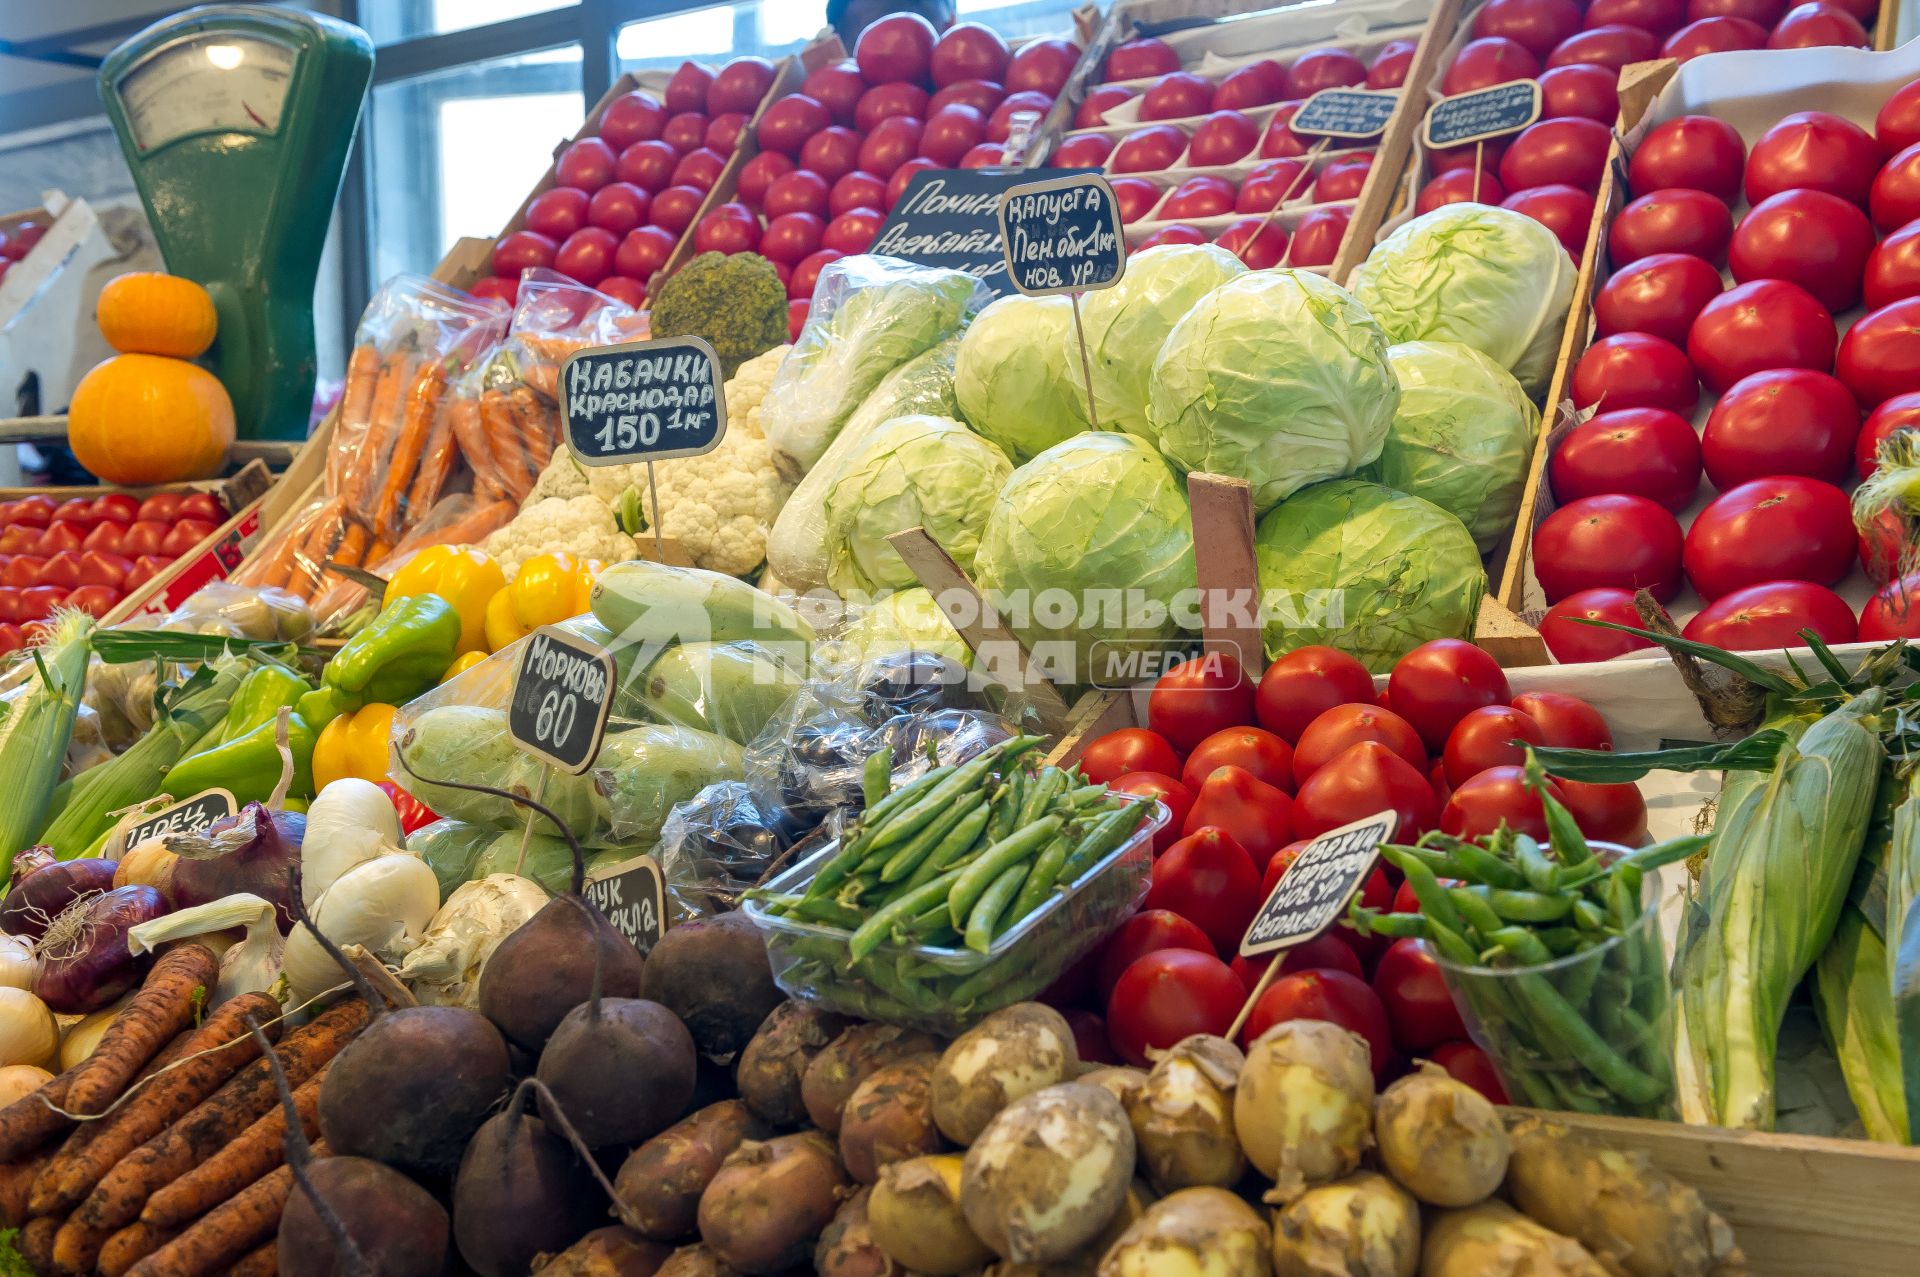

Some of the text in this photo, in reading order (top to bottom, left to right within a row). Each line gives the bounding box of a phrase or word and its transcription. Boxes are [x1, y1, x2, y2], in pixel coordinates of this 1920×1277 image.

[901, 179, 1001, 216] Помид
[570, 355, 711, 394] КАБАЧКИ
[594, 413, 661, 451] 150
[535, 690, 577, 748] 60
